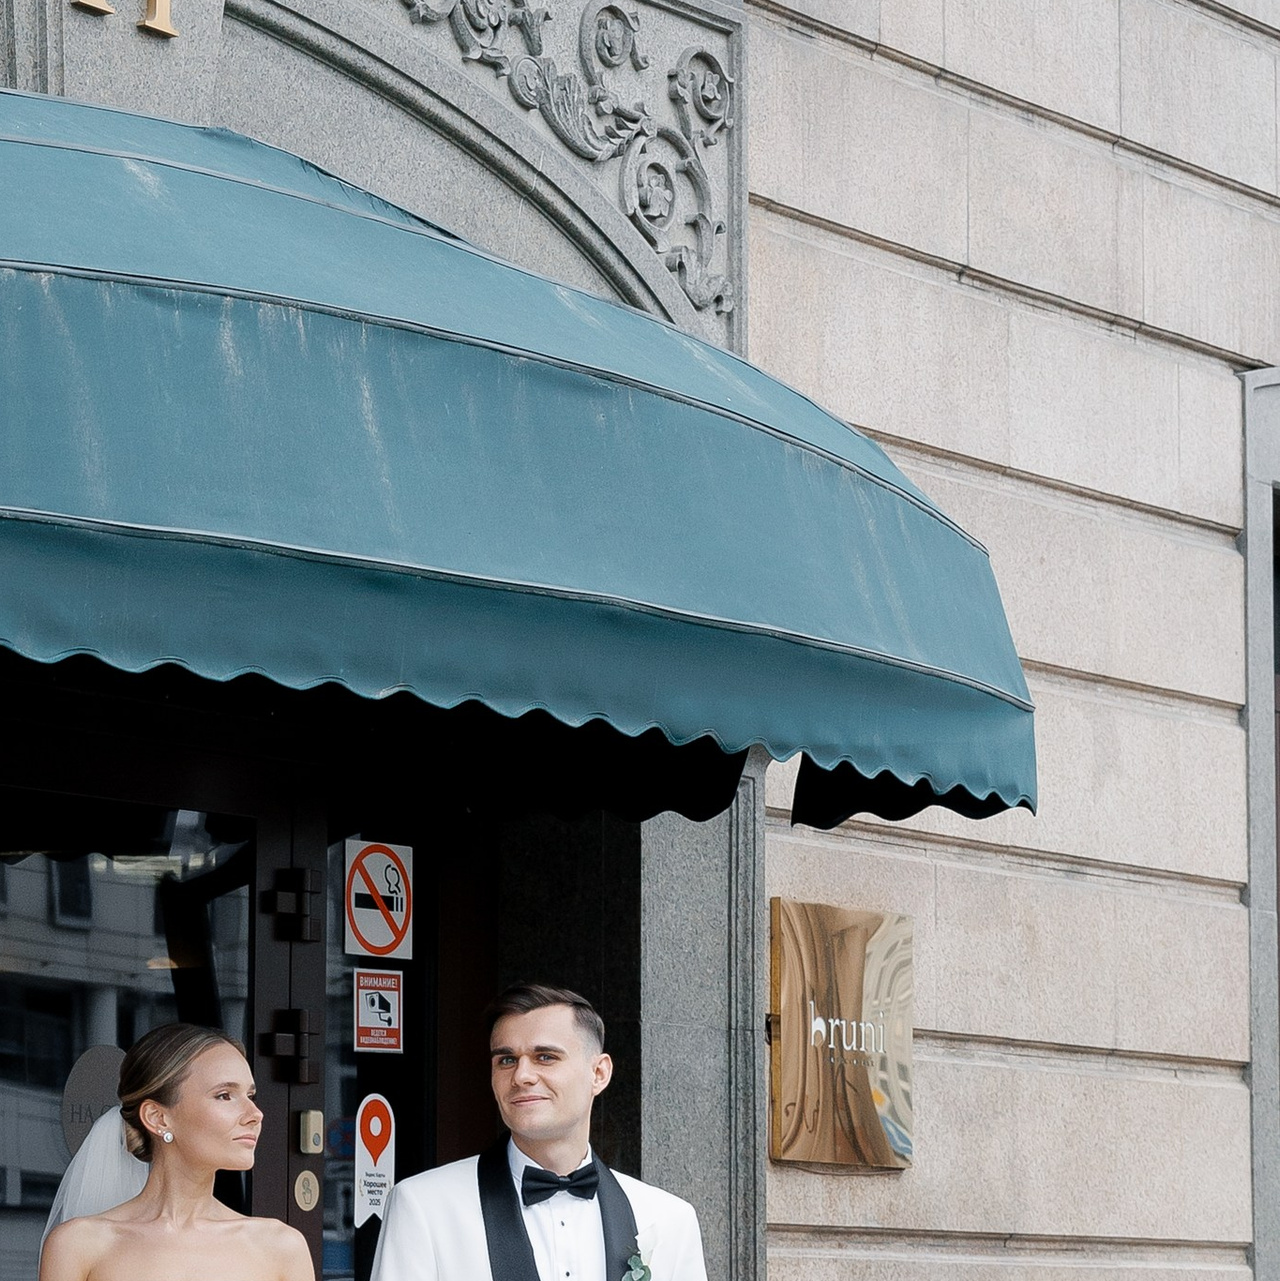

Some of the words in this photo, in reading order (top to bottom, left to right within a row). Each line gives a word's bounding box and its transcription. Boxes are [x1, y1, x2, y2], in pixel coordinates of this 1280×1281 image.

[359, 976, 398, 989] ВНИМАНИЕ!
[809, 1000, 887, 1054] bruni
[363, 1179, 387, 1189] Хорошее
[369, 1198, 381, 1206] 2025
